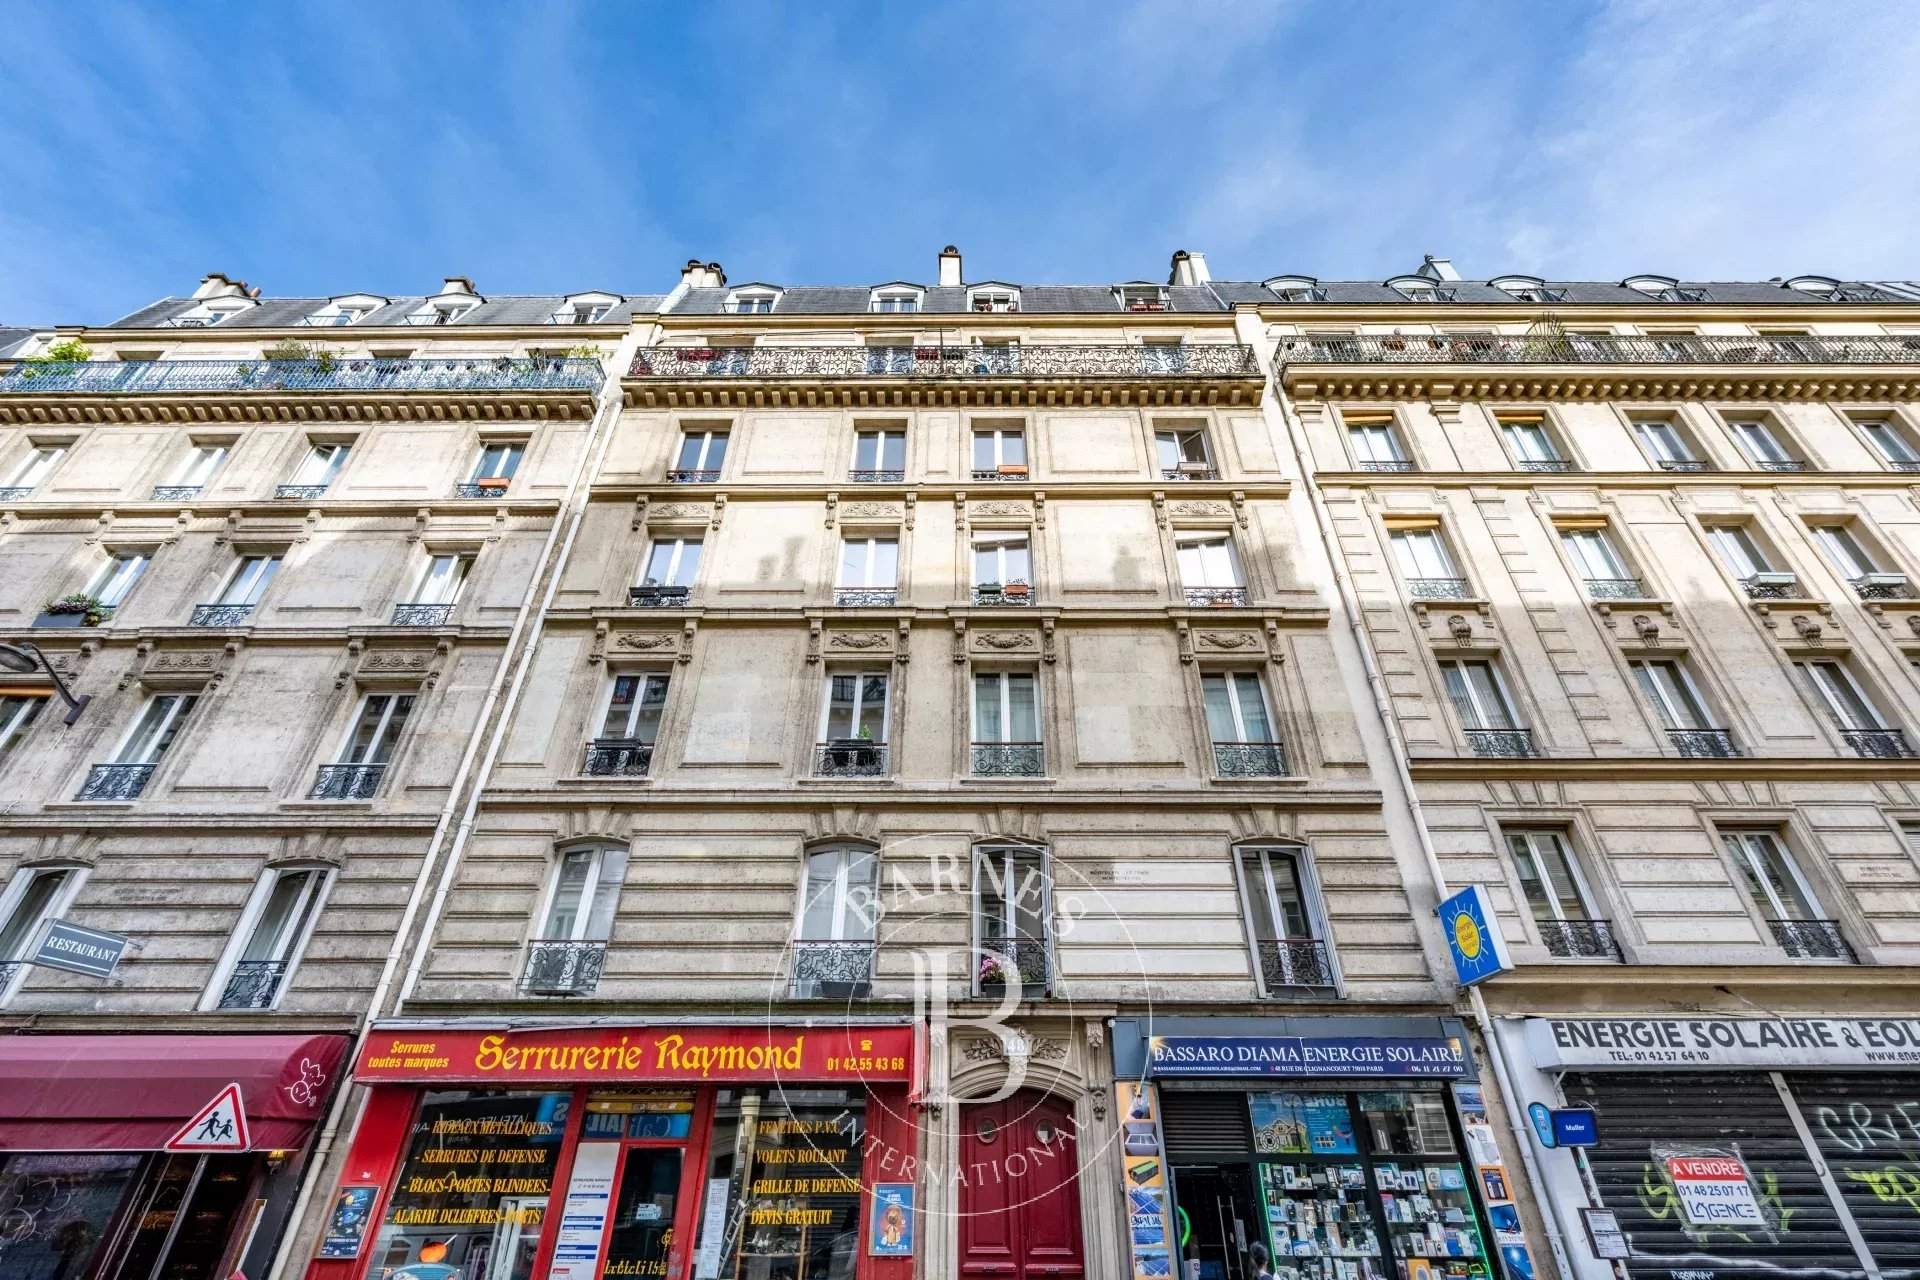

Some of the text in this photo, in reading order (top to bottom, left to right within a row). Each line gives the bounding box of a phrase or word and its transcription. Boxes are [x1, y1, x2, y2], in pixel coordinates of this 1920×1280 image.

[46, 935, 118, 962] RESTAURANT
[1553, 1021, 1686, 1048] ENERGIE
[1694, 1020, 1838, 1049] SOLAIRE
[1841, 1027, 1863, 1048] &
[390, 1040, 436, 1053] Serrures
[475, 1035, 804, 1077] Serrurerie Raymond
[1154, 1046, 1464, 1062] BASSARO DIAMA ENERGIE SOLAIRE
[1609, 1051, 1633, 1061] TEL:
[368, 1057, 449, 1071] toutes marques
[828, 1057, 905, 1071] 01 42 55 43 68
[421, 1149, 547, 1163] SERRURES DE DEFENSE
[756, 1149, 847, 1163] VOLETS ROULANT
[1673, 1162, 1740, 1176] A VENDRE
[493, 1178, 547, 1193] BLINDEES
[753, 1179, 861, 1193] GRILLE DE DEFENSE
[1679, 1185, 1749, 1196] 01 48 25 07 17
[750, 1209, 832, 1224] DEVIS GRATUIT
